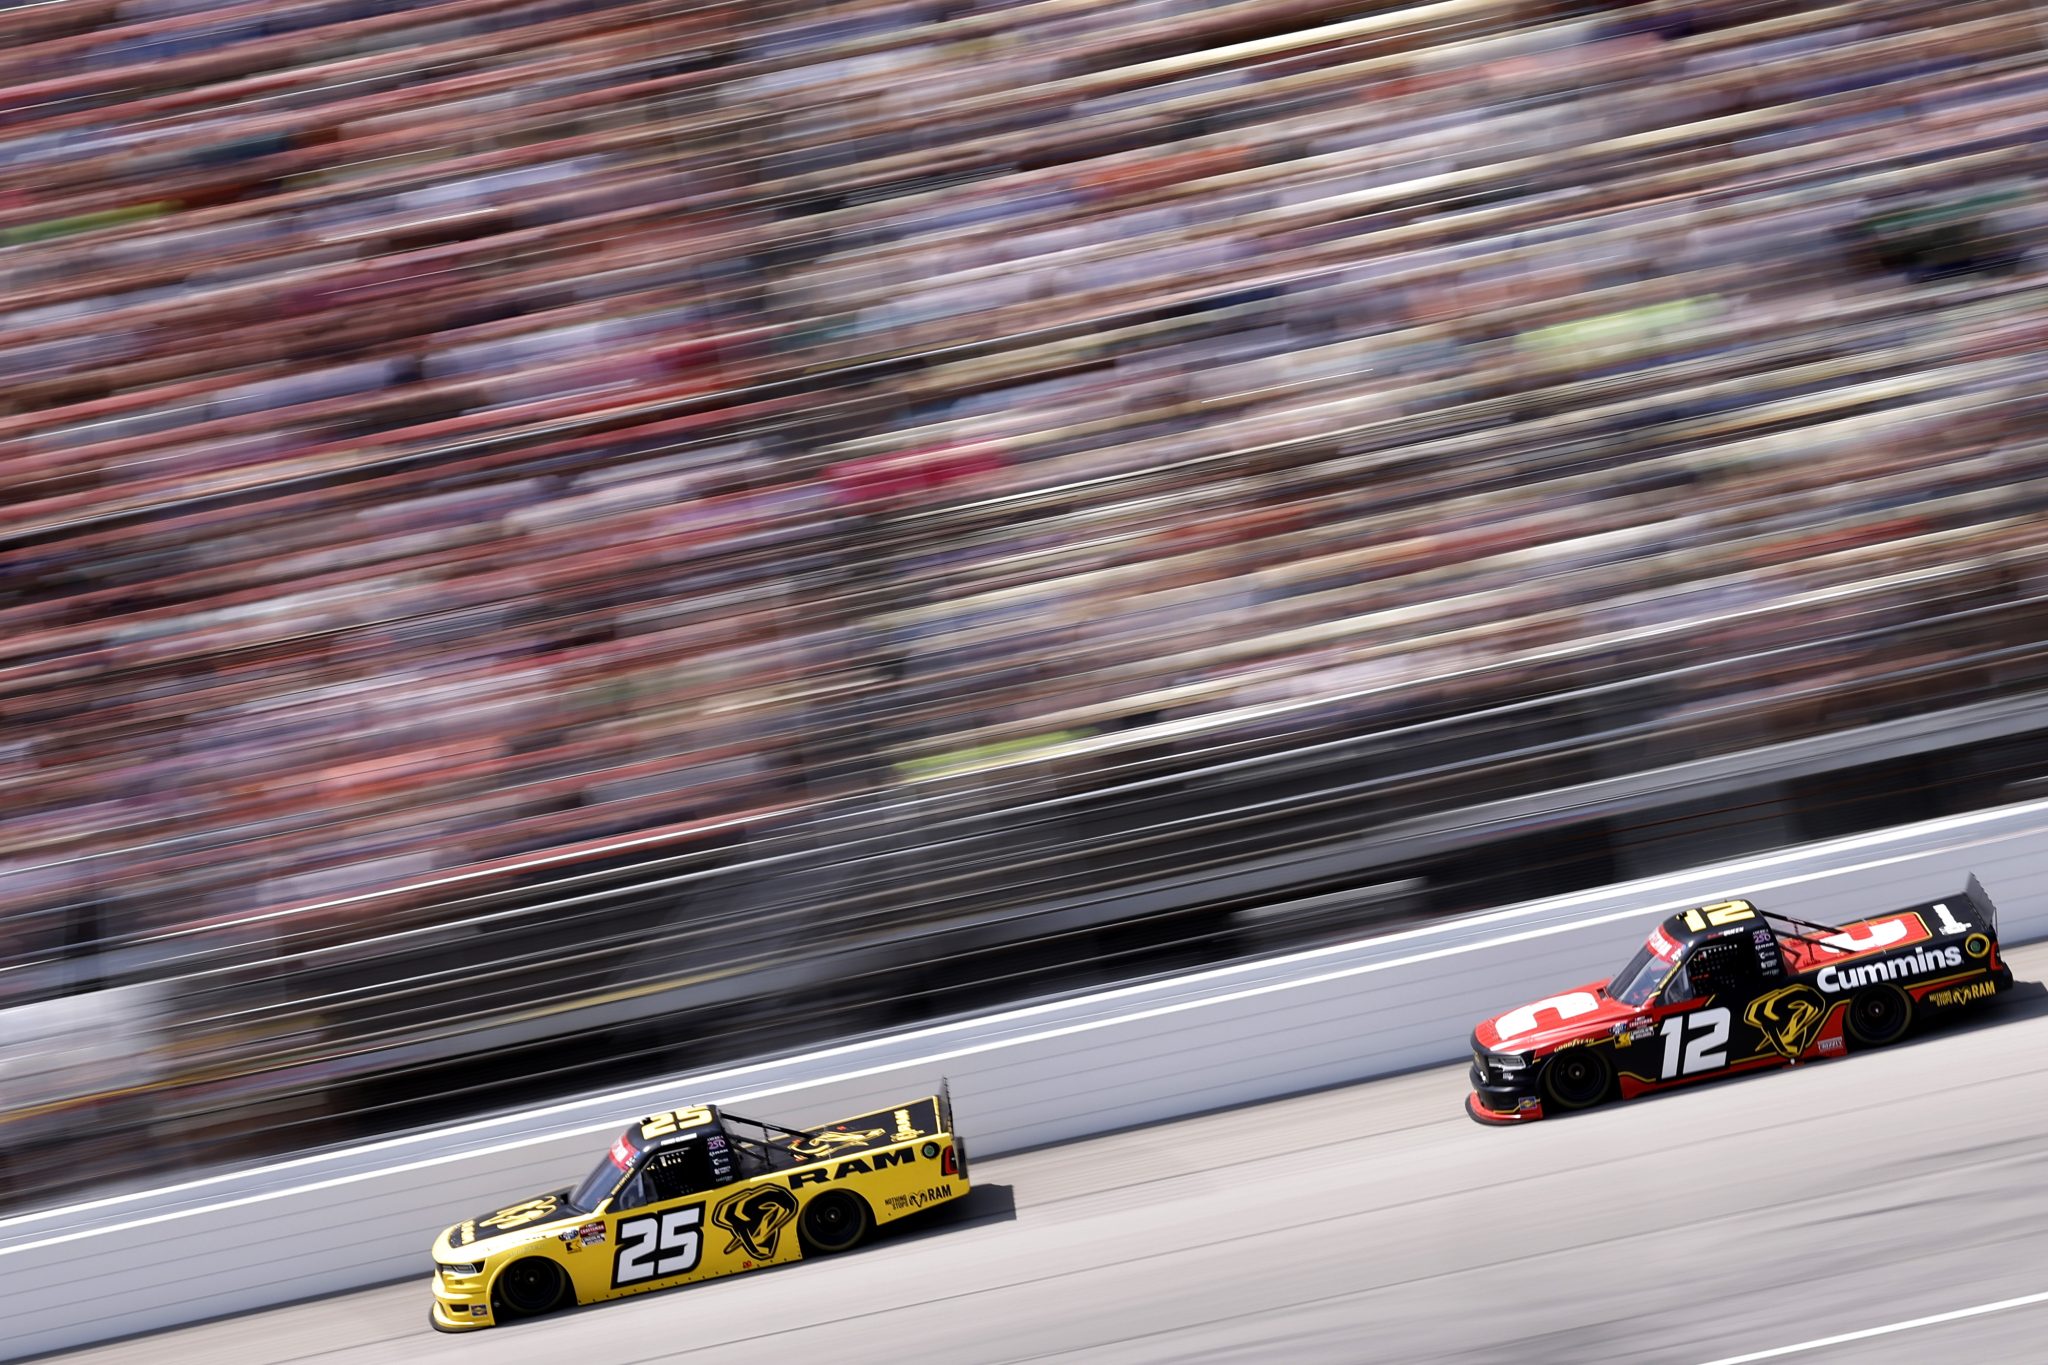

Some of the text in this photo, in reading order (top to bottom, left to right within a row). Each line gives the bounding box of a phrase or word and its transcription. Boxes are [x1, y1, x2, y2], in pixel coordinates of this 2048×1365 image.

[1684, 900, 1755, 932] 12
[1753, 932, 1771, 944] 250
[1817, 946, 1963, 993] Cummins
[1971, 980, 1996, 999] RAM
[1660, 1006, 1731, 1080] 12
[641, 1105, 713, 1140] 25
[707, 1139, 726, 1150] 250
[788, 1147, 915, 1190] RAM
[927, 1184, 952, 1201] RAM
[616, 1207, 700, 1283] 25
